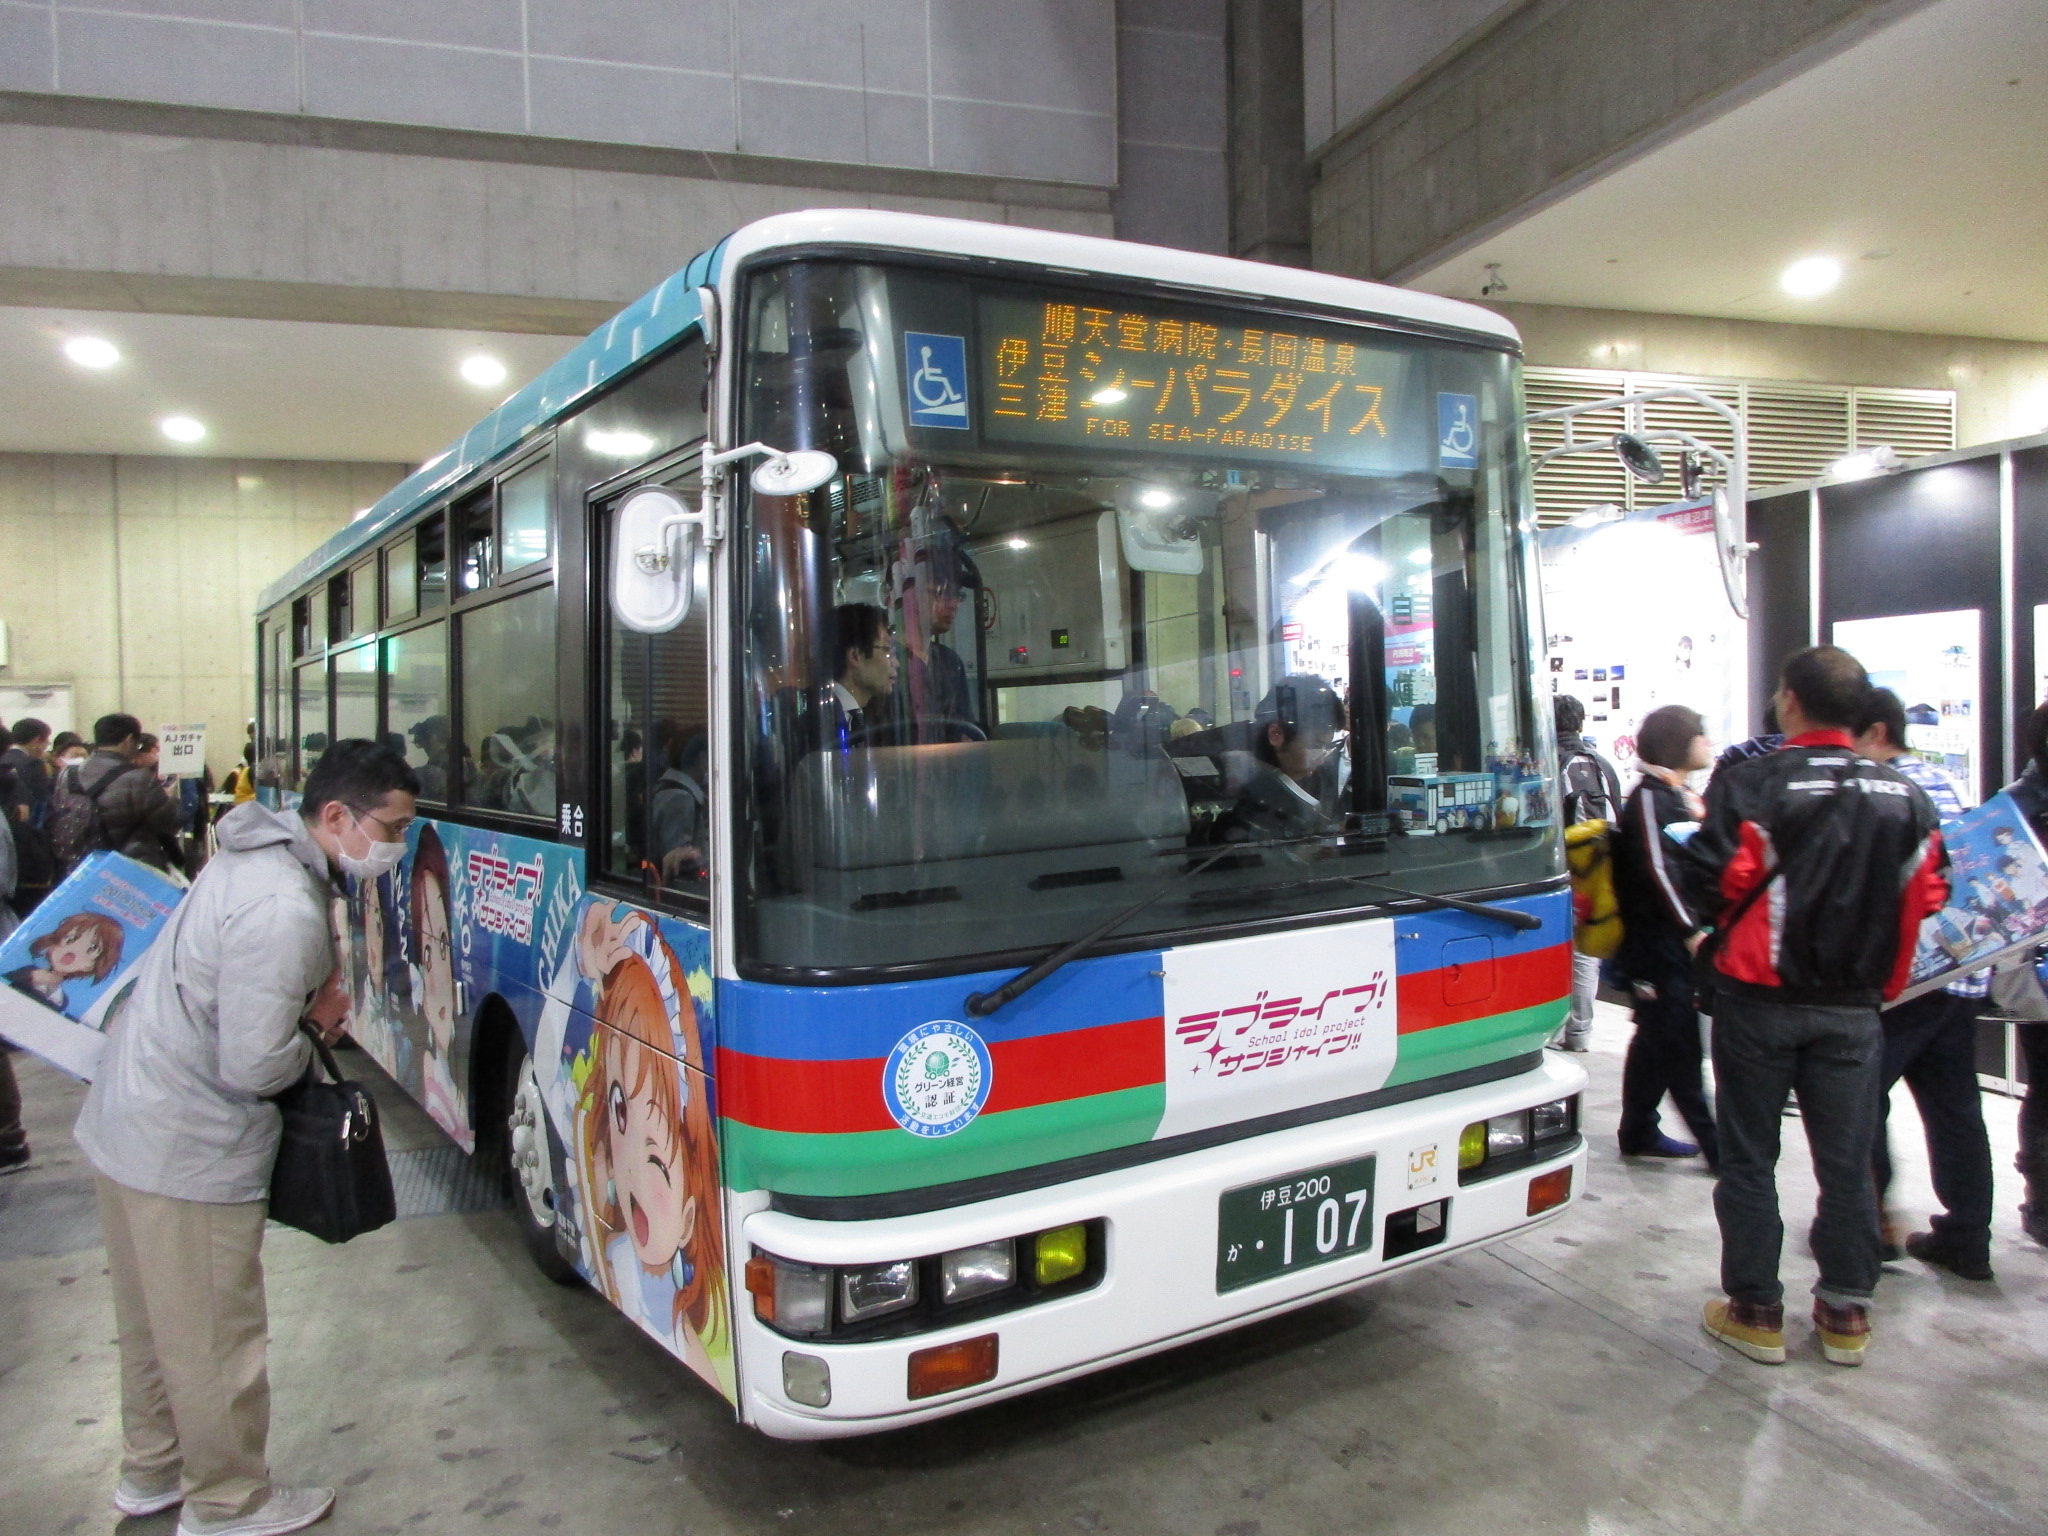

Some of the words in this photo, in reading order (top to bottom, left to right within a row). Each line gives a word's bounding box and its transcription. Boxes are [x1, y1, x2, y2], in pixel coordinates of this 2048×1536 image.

[1086, 417, 1131, 437] FOR
[1148, 423, 1314, 452] SEA-PARADISE
[173, 744, 194, 756] 出口
[561, 803, 584, 838] 乗合
[538, 857, 582, 995] CHIKA
[1248, 1030, 1288, 1048] School
[1293, 1025, 1319, 1041] idol
[1322, 1016, 1366, 1036] project
[914, 1076, 964, 1093] グリーン経営
[1411, 1150, 1436, 1173] JR
[1227, 1243, 1243, 1262] か
